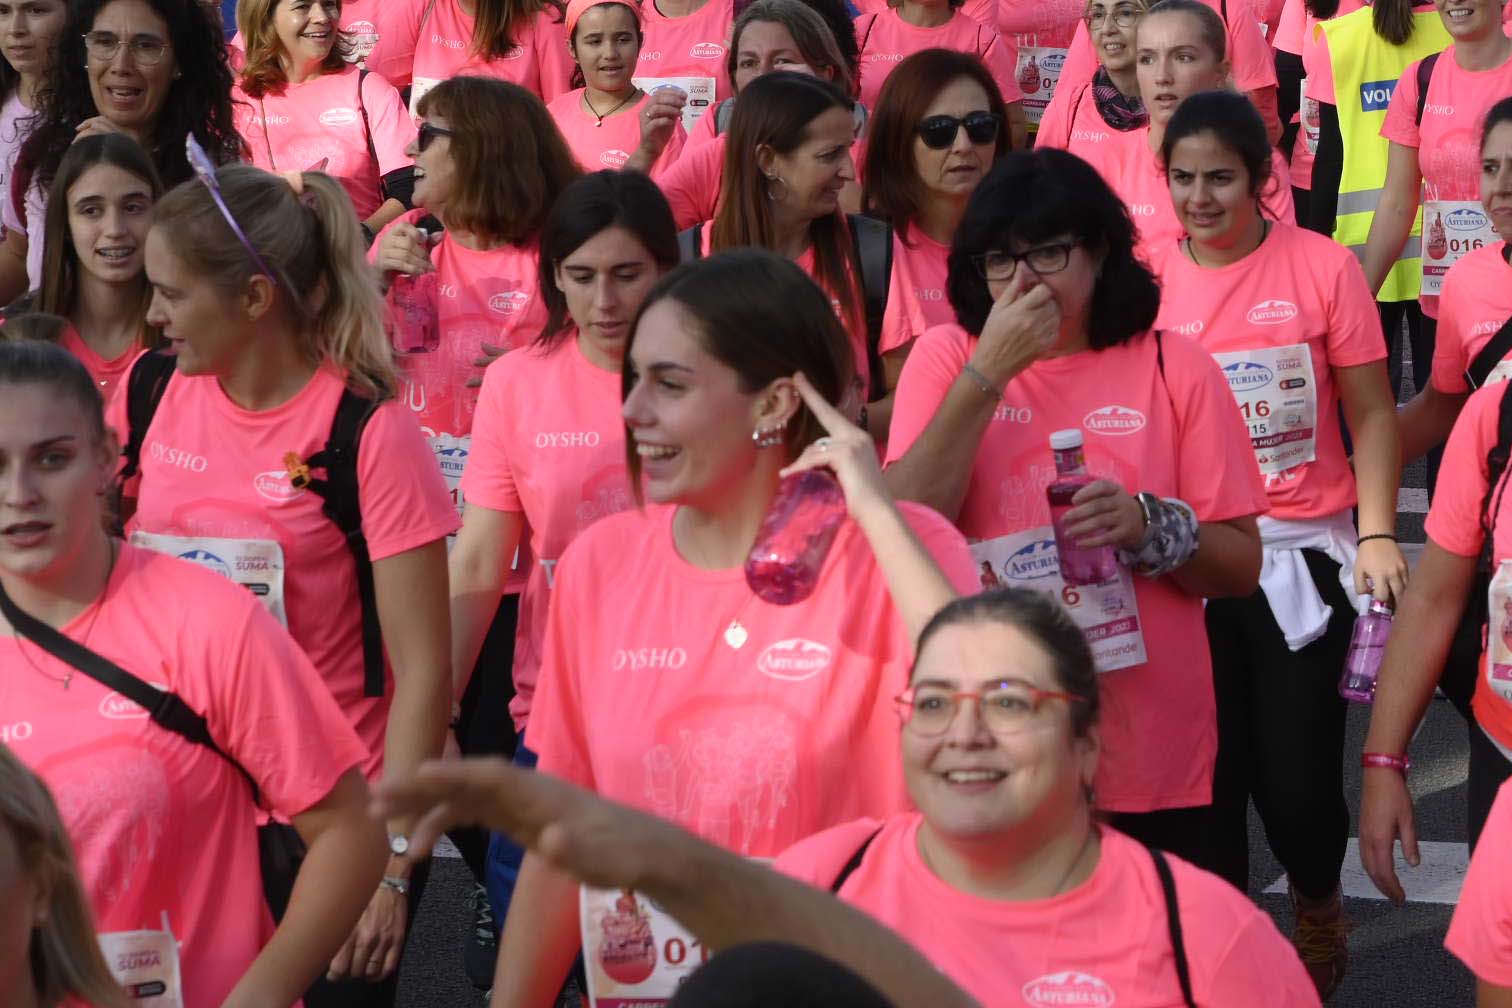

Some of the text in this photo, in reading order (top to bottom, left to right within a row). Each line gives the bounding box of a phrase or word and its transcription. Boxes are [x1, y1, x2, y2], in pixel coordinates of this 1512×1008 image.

[1015, 33, 1037, 48] TU
[1425, 103, 1455, 116] YSHO
[1447, 216, 1484, 226] ASTURIANA
[1251, 307, 1295, 320] ASTURIANA
[1240, 399, 1270, 418] 16
[1087, 415, 1142, 430] ASTURIANA
[535, 431, 600, 449] OYSHO
[235, 559, 269, 571] SUMA
[1062, 584, 1080, 606] 6
[612, 647, 687, 672] OYSHO
[118, 954, 161, 971] SUMA
[1030, 986, 1108, 1007] ASTURIANA
